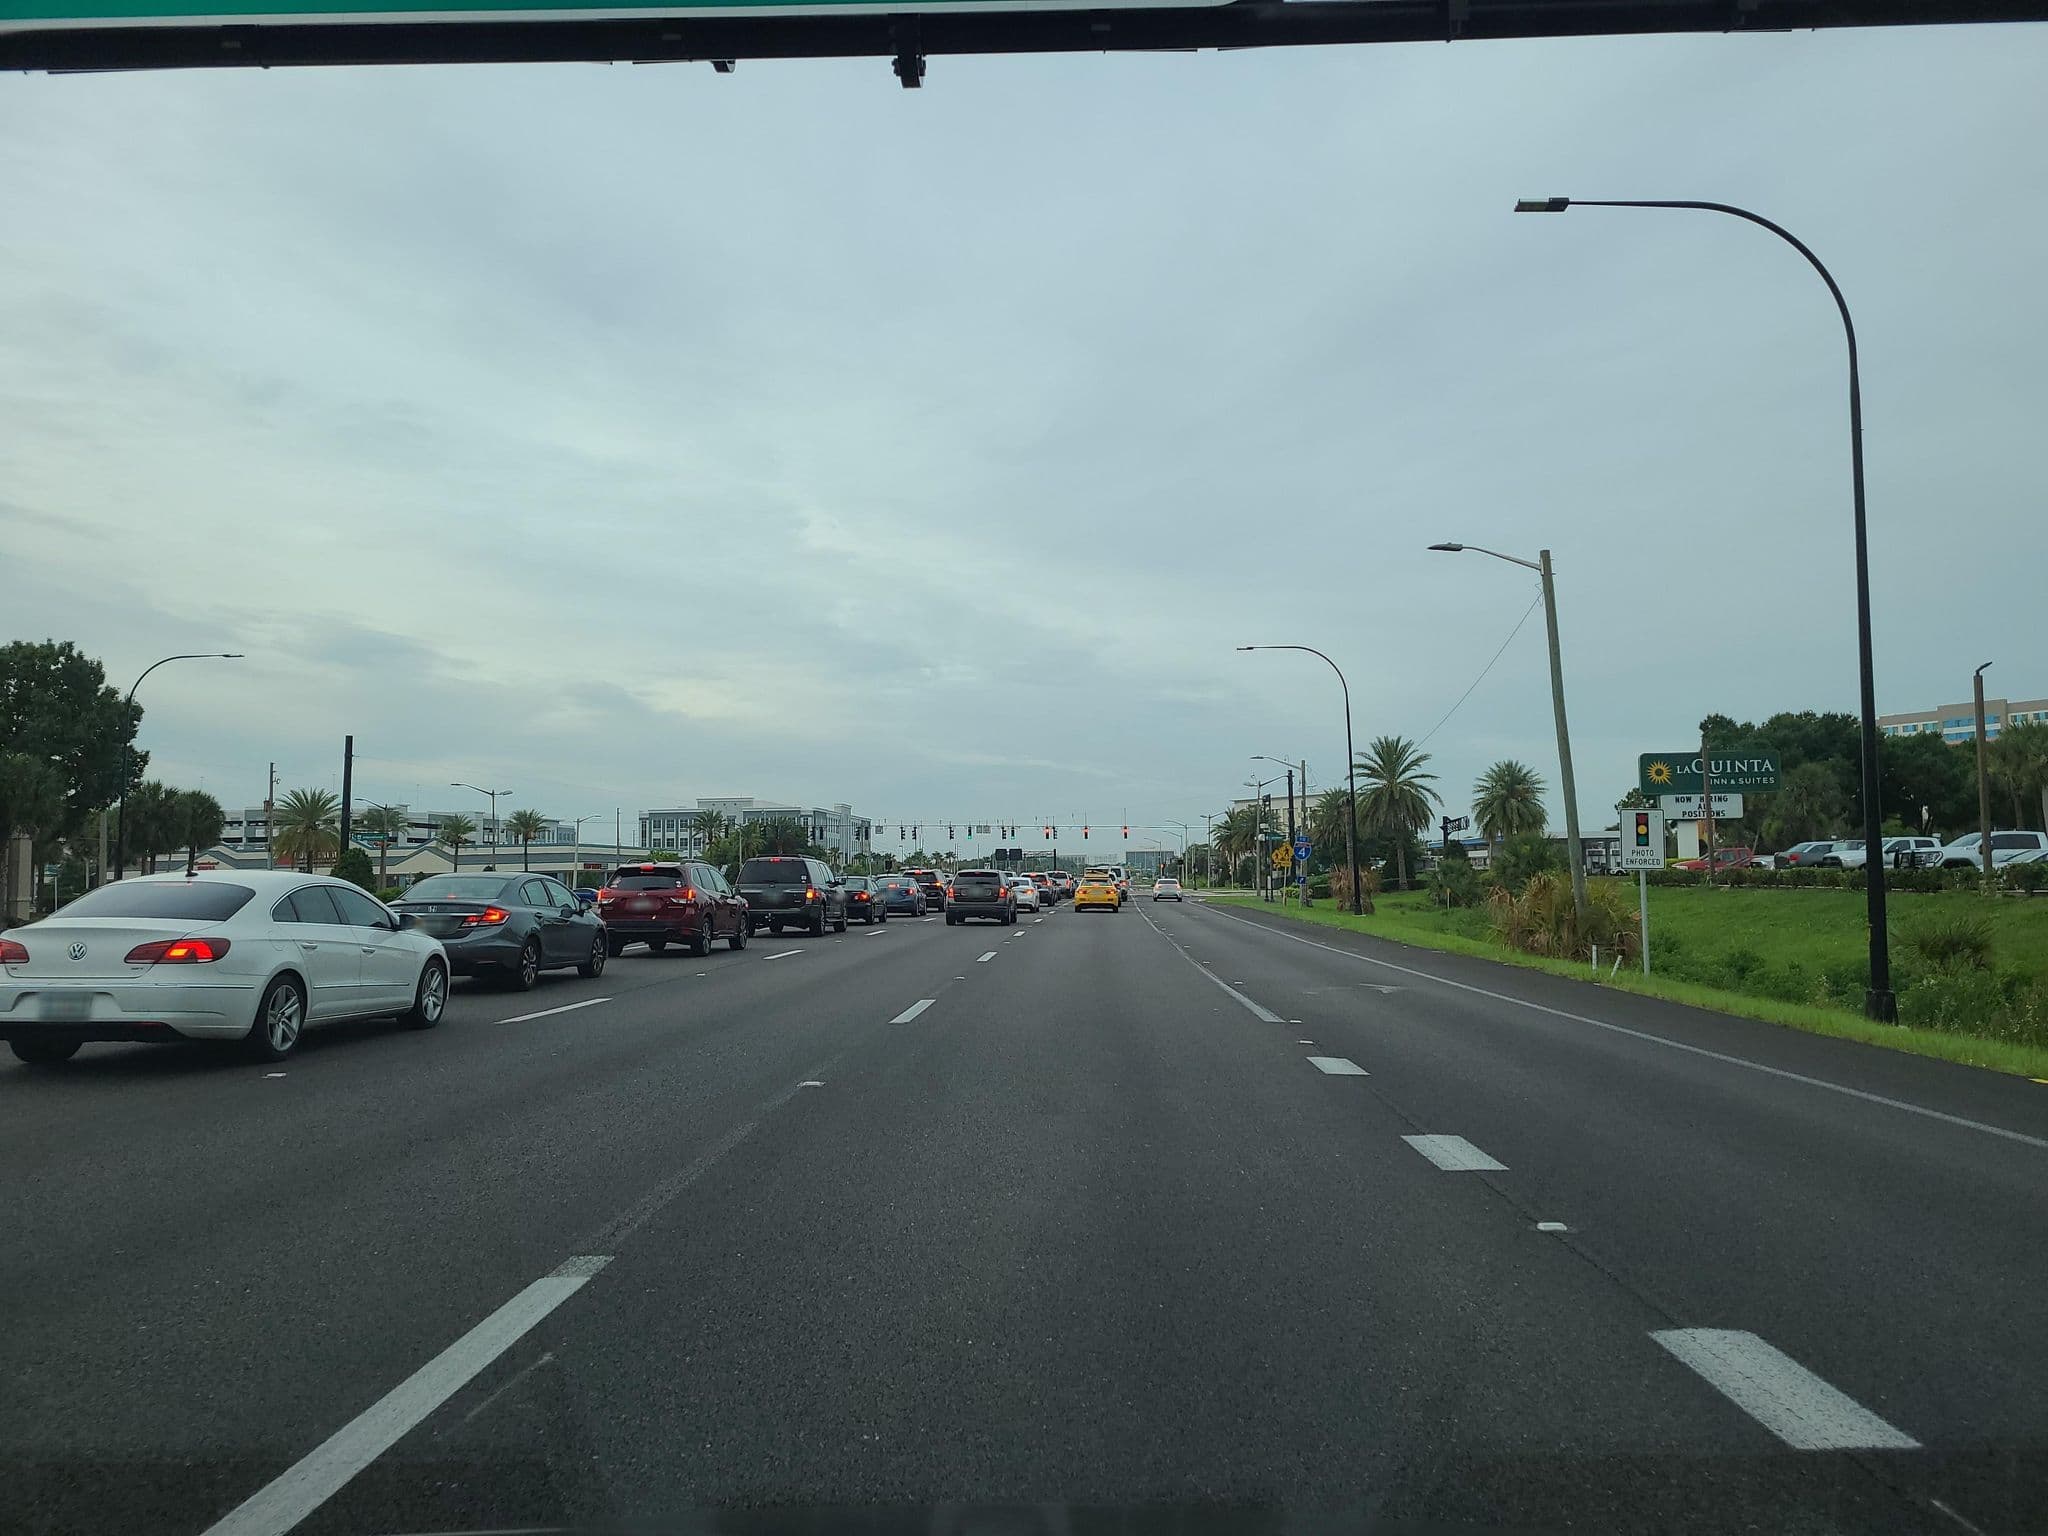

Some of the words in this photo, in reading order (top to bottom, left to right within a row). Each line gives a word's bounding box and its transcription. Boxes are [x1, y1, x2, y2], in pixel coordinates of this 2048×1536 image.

[1676, 765, 1691, 774] LA
[1691, 758, 1775, 777] QUINTA
[1738, 777, 1775, 785] SUITES
[1675, 795, 1692, 803] NOW
[1699, 795, 1729, 803] HRING
[1681, 810, 1726, 818] POSITONS
[1298, 847, 1305, 857] 4
[1631, 849, 1654, 857] PHOTO
[1625, 858, 1661, 866] ENFORCED
